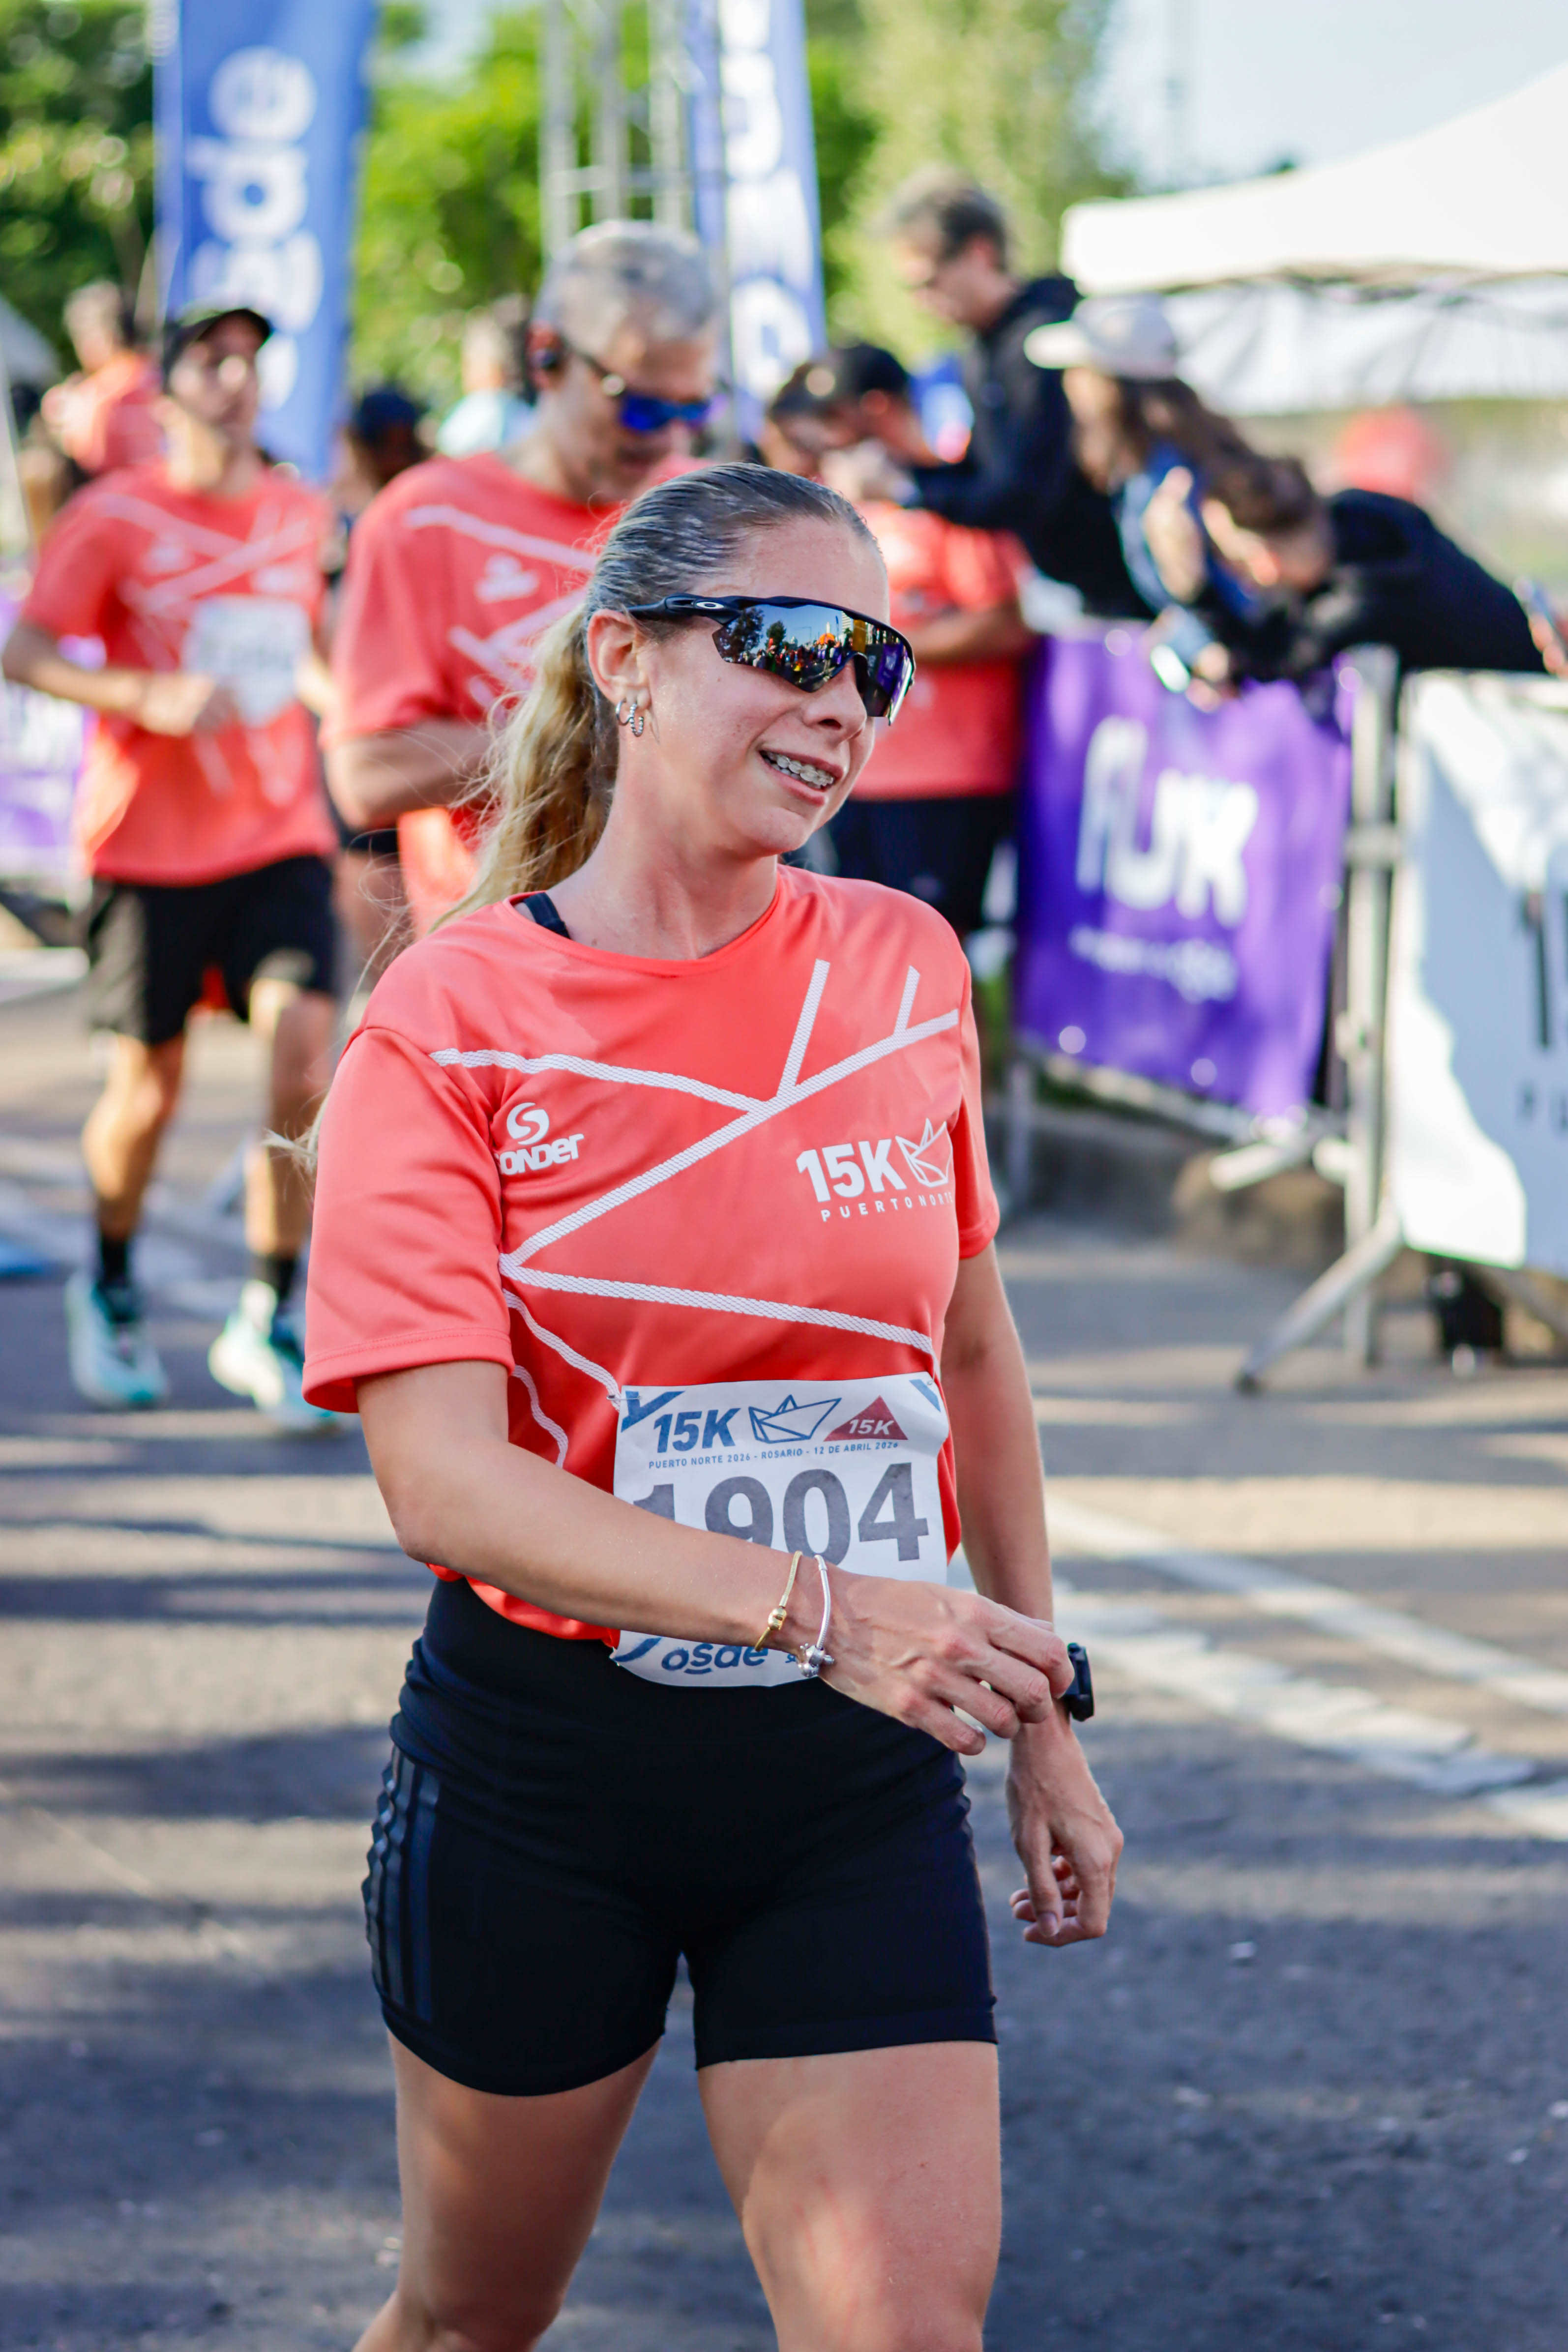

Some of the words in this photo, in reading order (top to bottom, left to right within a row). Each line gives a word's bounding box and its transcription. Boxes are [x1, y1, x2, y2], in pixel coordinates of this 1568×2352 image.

[796, 1139, 907, 1203] 15K
[821, 1196, 913, 1222] PUERTO
[653, 1408, 741, 1453] 15K
[849, 1418, 894, 1435] 15K
[649, 1458, 687, 1469] PUERTO
[691, 1455, 723, 1465] NORTE
[728, 1453, 750, 1462] 2026
[762, 1448, 803, 1459] ROSARIO
[828, 1445, 840, 1454] DE
[844, 1443, 871, 1452] ABRIL
